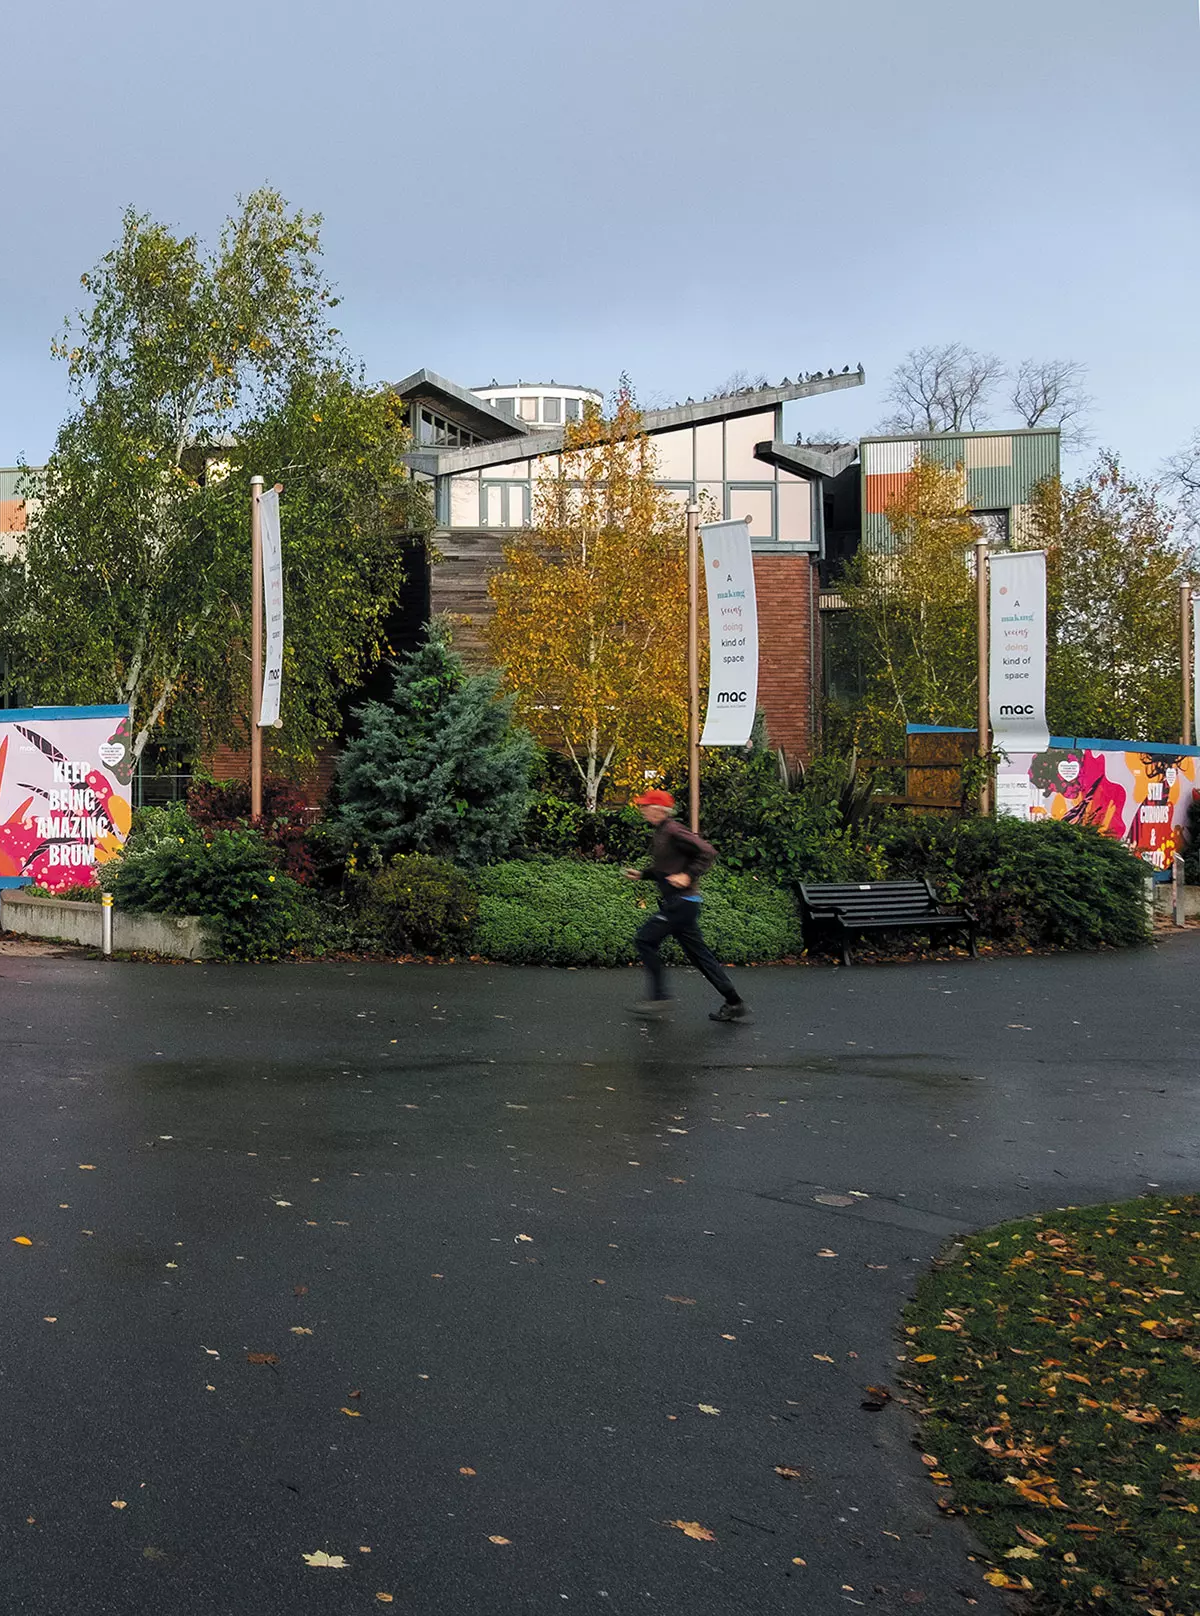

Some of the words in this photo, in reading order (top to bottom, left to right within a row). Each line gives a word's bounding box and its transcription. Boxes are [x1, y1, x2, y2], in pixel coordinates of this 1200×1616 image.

[726, 573, 733, 582] A
[717, 589, 745, 599] making
[720, 605, 742, 617] seeing
[1001, 612, 1034, 623] making
[722, 623, 743, 632] doing
[1003, 628, 1029, 638] seeing
[721, 638, 736, 647] kind
[738, 637, 746, 646] of
[1004, 643, 1028, 652] doing
[723, 655, 745, 664] space
[1002, 657, 1020, 665] kind
[1022, 656, 1031, 664] of
[1004, 672, 1029, 680] space
[717, 691, 747, 703] mac
[999, 704, 1034, 715] mac
[53, 761, 90, 782] KEEP
[1147, 783, 1164, 801] STAY
[49, 789, 96, 811] BEING
[36, 816, 108, 838] AMAZING
[1150, 828, 1156, 846] &
[49, 844, 96, 866] BRUM
